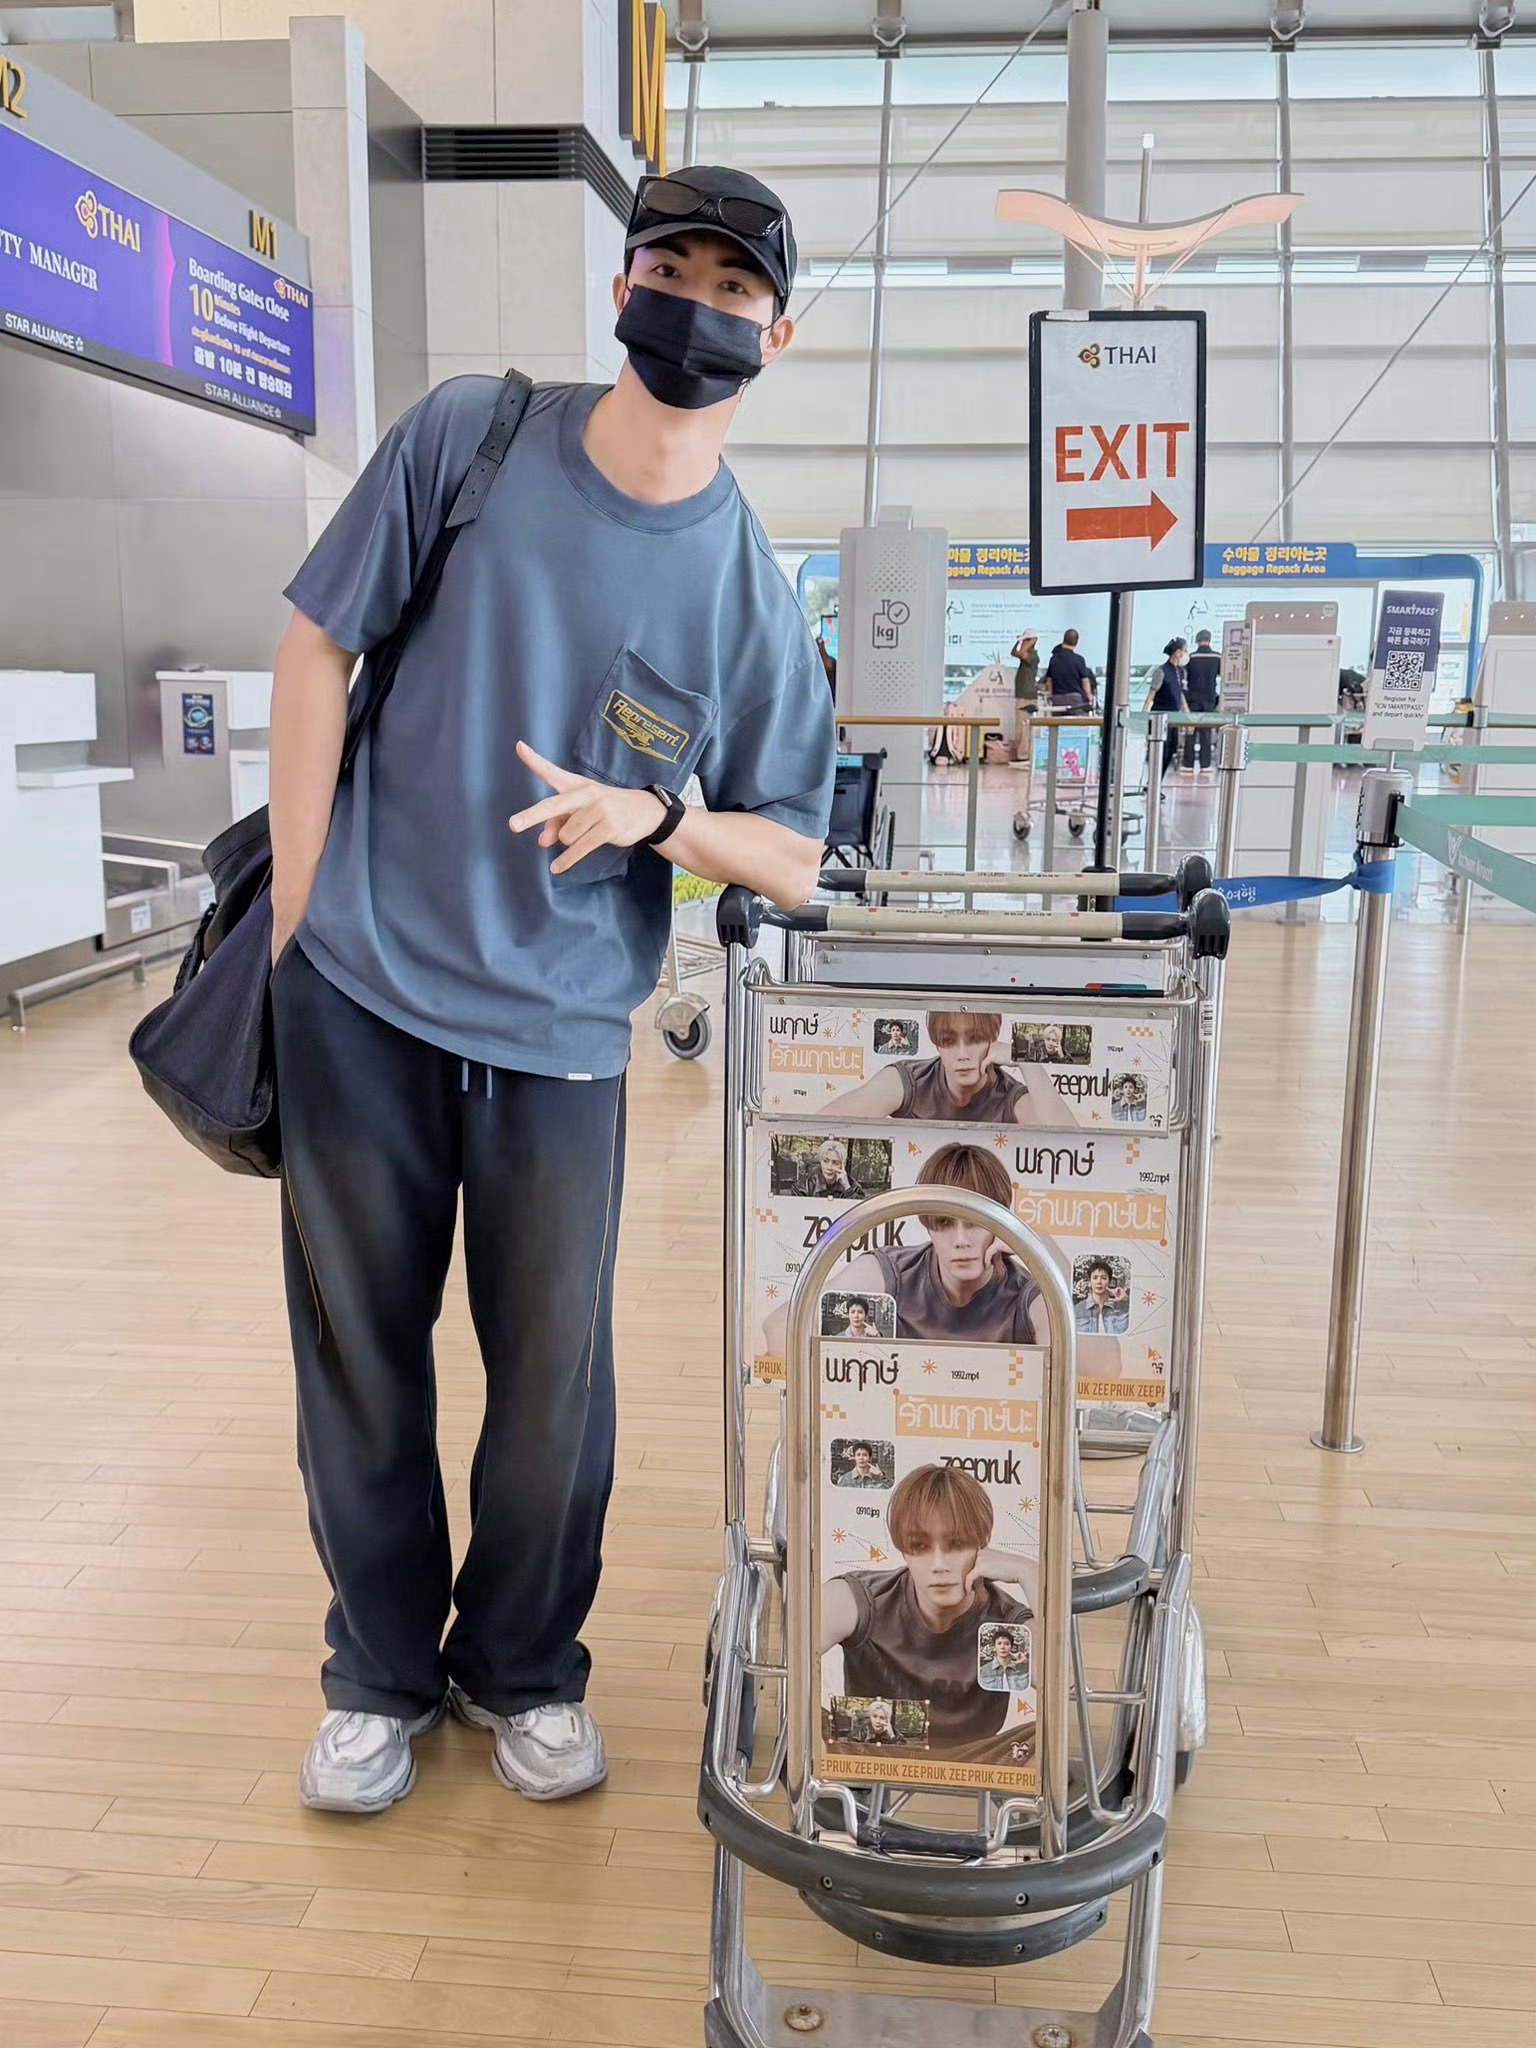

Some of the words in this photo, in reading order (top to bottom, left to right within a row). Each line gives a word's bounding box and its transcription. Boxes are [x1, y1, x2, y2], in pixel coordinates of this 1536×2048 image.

[97, 203, 141, 253] THAI
[251, 209, 278, 260] M1
[0, 228, 23, 259] TY
[29, 241, 98, 292] MANAGER
[188, 256, 238, 301] Boarding
[238, 283, 265, 311] Gates
[265, 296, 290, 322] Close
[188, 283, 215, 322] 10
[285, 284, 309, 308] THAI
[5, 313, 30, 334] STAR
[31, 322, 75, 350] ALLIANCE
[214, 310, 238, 333] Before
[238, 321, 258, 343] Flight
[1104, 345, 1157, 365] THAI
[204, 382, 231, 400] STAR
[232, 392, 275, 416] ALLIANCE
[1055, 422, 1190, 483] EXIT
[948, 548, 971, 563] 하물
[1222, 564, 1264, 576] Baggage
[1266, 564, 1300, 576] Repack
[1302, 564, 1327, 574] Area
[1386, 603, 1436, 616] SMARTPASS
[876, 625, 894, 641] kg
[613, 699, 680, 747] Represent
[770, 1013, 819, 1040] พฤกษ์
[1016, 1142, 1095, 1184] พฤกษ์
[1139, 1171, 1170, 1185] 1992.mp4
[826, 1353, 899, 1391] พฤกษ์
[951, 1370, 979, 1382] 1992.mp4
[856, 1506, 880, 1518] 0910.jpg
